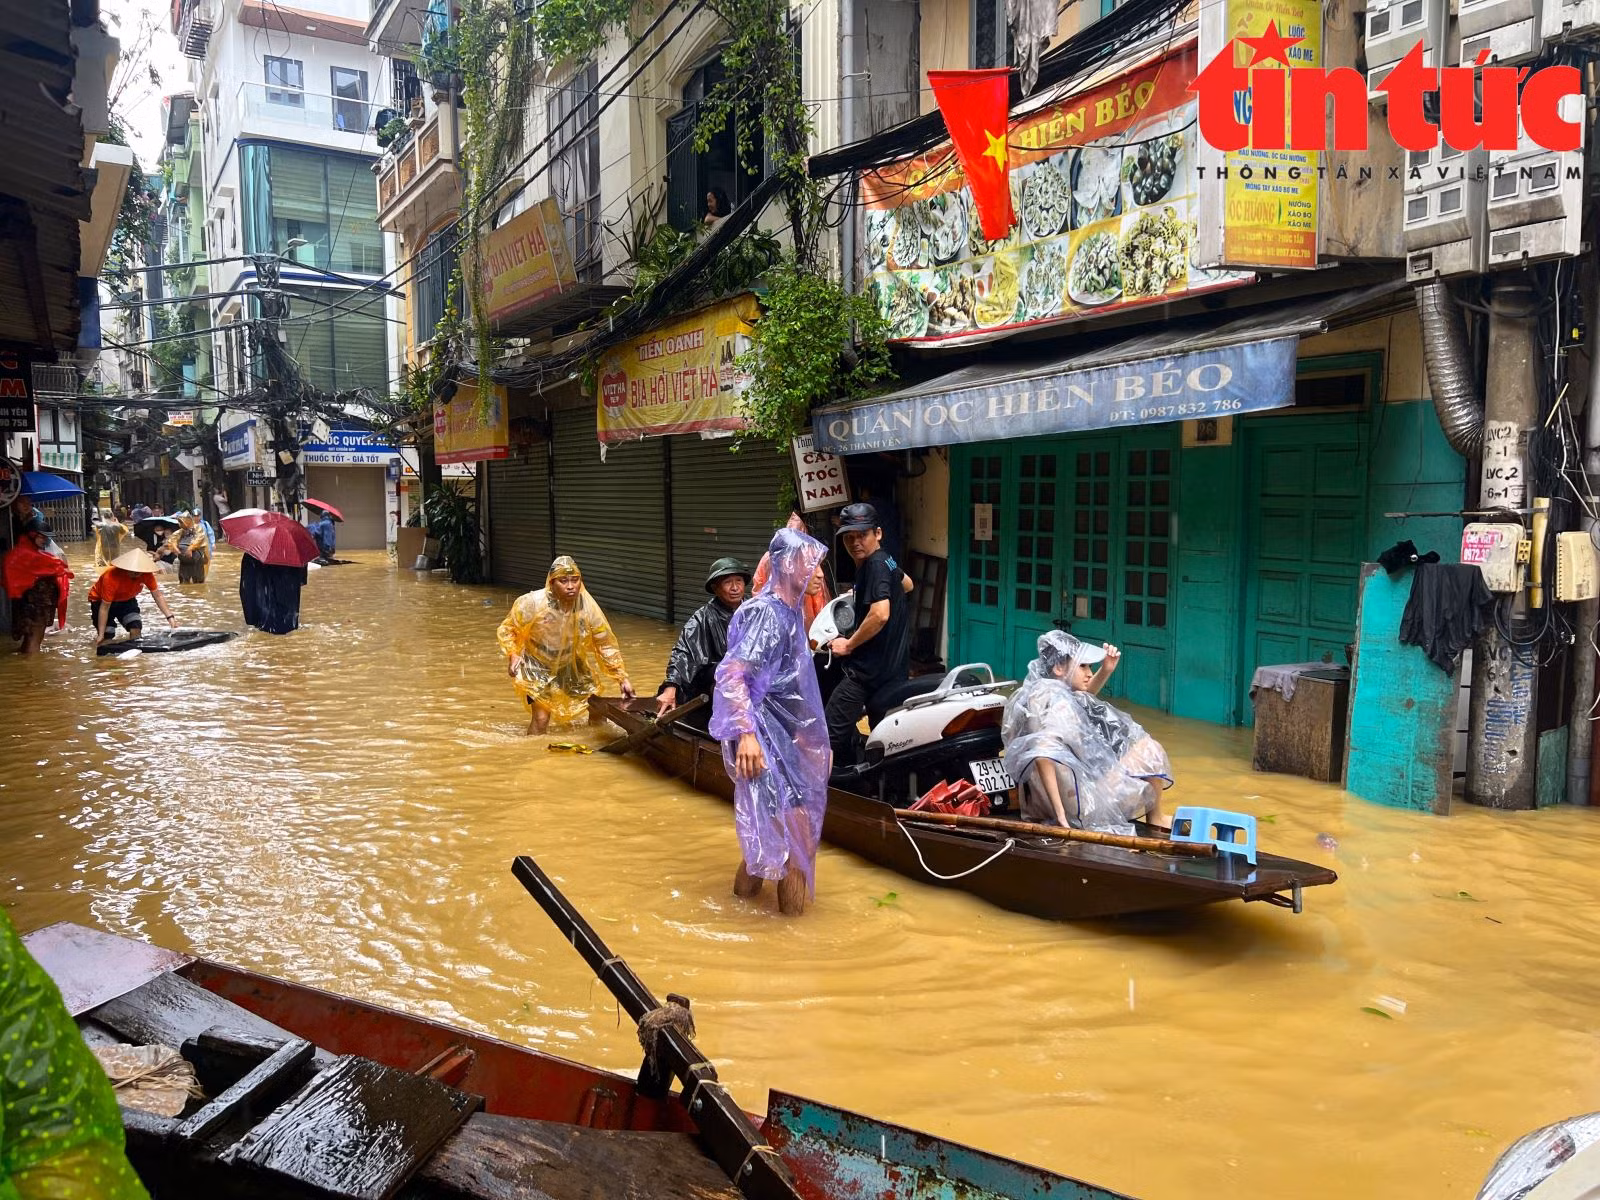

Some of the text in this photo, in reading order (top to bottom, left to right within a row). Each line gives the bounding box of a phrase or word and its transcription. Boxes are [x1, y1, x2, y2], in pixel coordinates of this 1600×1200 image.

[1018, 105, 1086, 155] HIỀN
[1094, 80, 1156, 127] BÉO
[638, 328, 705, 361] TIẾN OANH
[631, 379, 647, 408] BIA
[672, 359, 697, 409] VIỆT
[828, 362, 1233, 441] QUÁN ỐC HIỀN BÉO
[1213, 398, 1242, 412] 786
[838, 444, 848, 452] 26
[304, 453, 329, 462] THUỐC
[332, 453, 345, 462] TỐT
[366, 453, 379, 462] TỐT
[805, 484, 843, 501] NAM
[976, 759, 1005, 776] 29-C1
